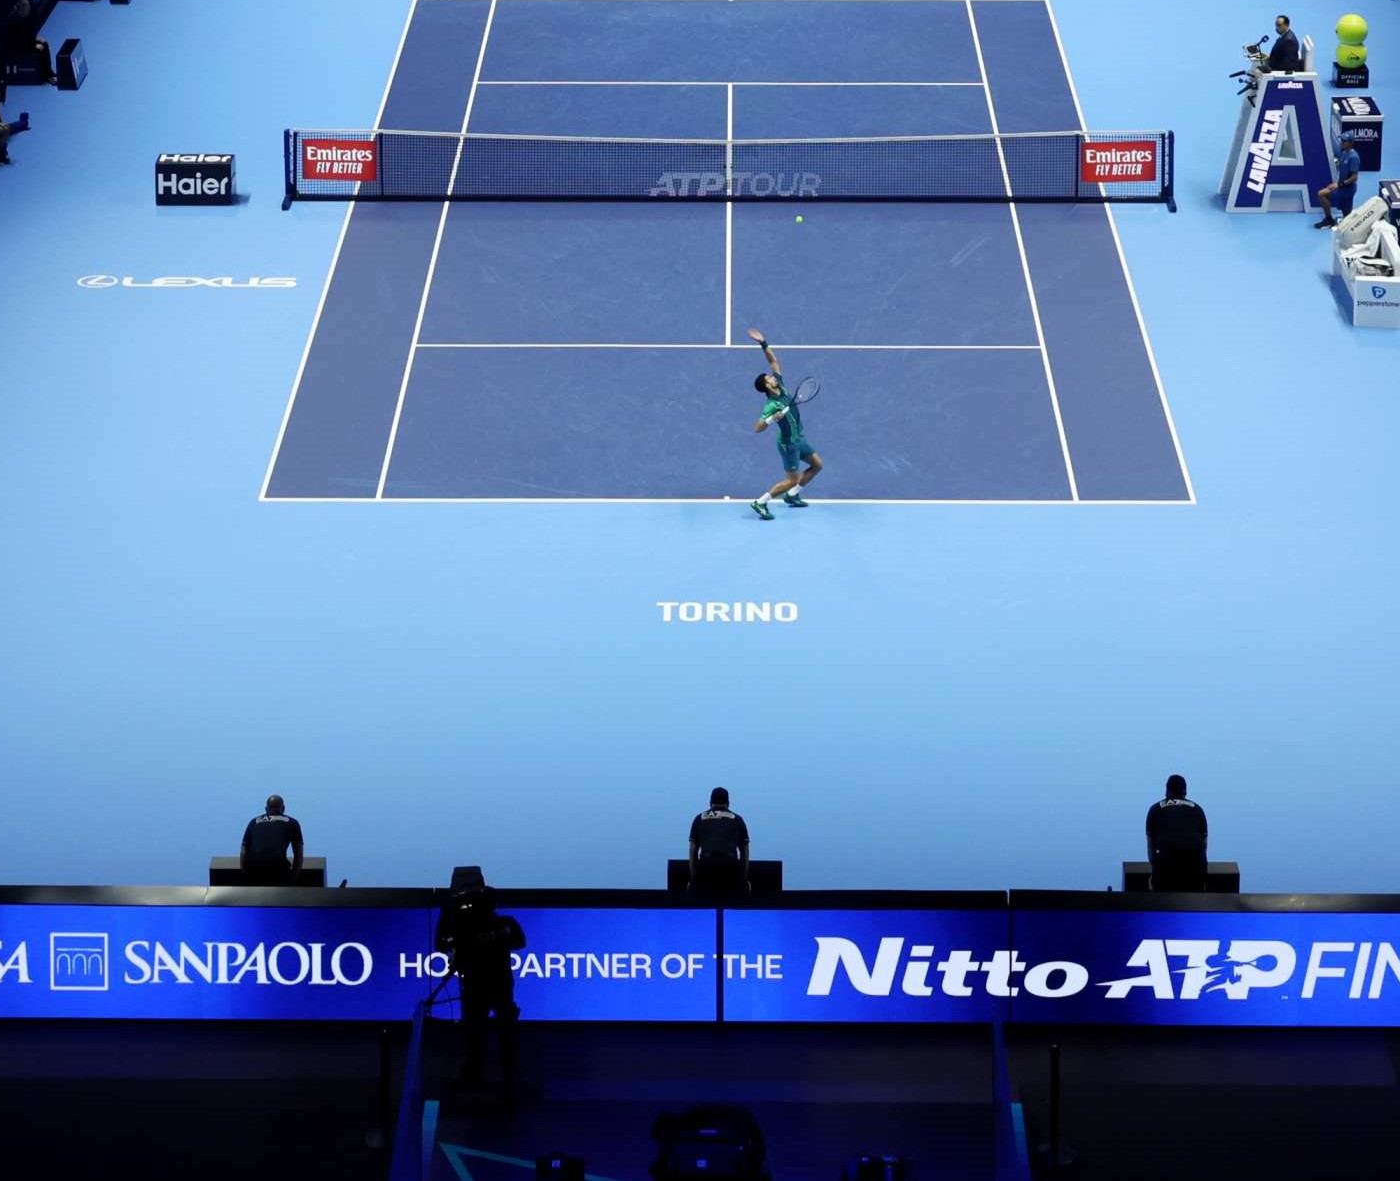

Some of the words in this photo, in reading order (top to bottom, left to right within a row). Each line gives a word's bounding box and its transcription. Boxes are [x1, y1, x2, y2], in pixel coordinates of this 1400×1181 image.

[159, 154, 232, 162] Haier
[306, 146, 373, 161] Emirates
[1085, 148, 1152, 163] Emirates
[1246, 109, 1283, 194] LAVAZZA
[316, 162, 331, 173] FLY
[332, 162, 363, 174] BETTER
[1096, 164, 1109, 176] FLY
[1112, 164, 1143, 175] BETTER
[158, 172, 228, 194] Haier
[122, 277, 297, 288] LEXUS
[657, 602, 797, 621] TORINO
[125, 941, 372, 985] SANPAOLO
[400, 952, 451, 978] HO
[661, 954, 704, 978] OF
[714, 954, 783, 978] THE
[806, 935, 1089, 998] Nitto
[1095, 938, 1295, 1000] ATP
